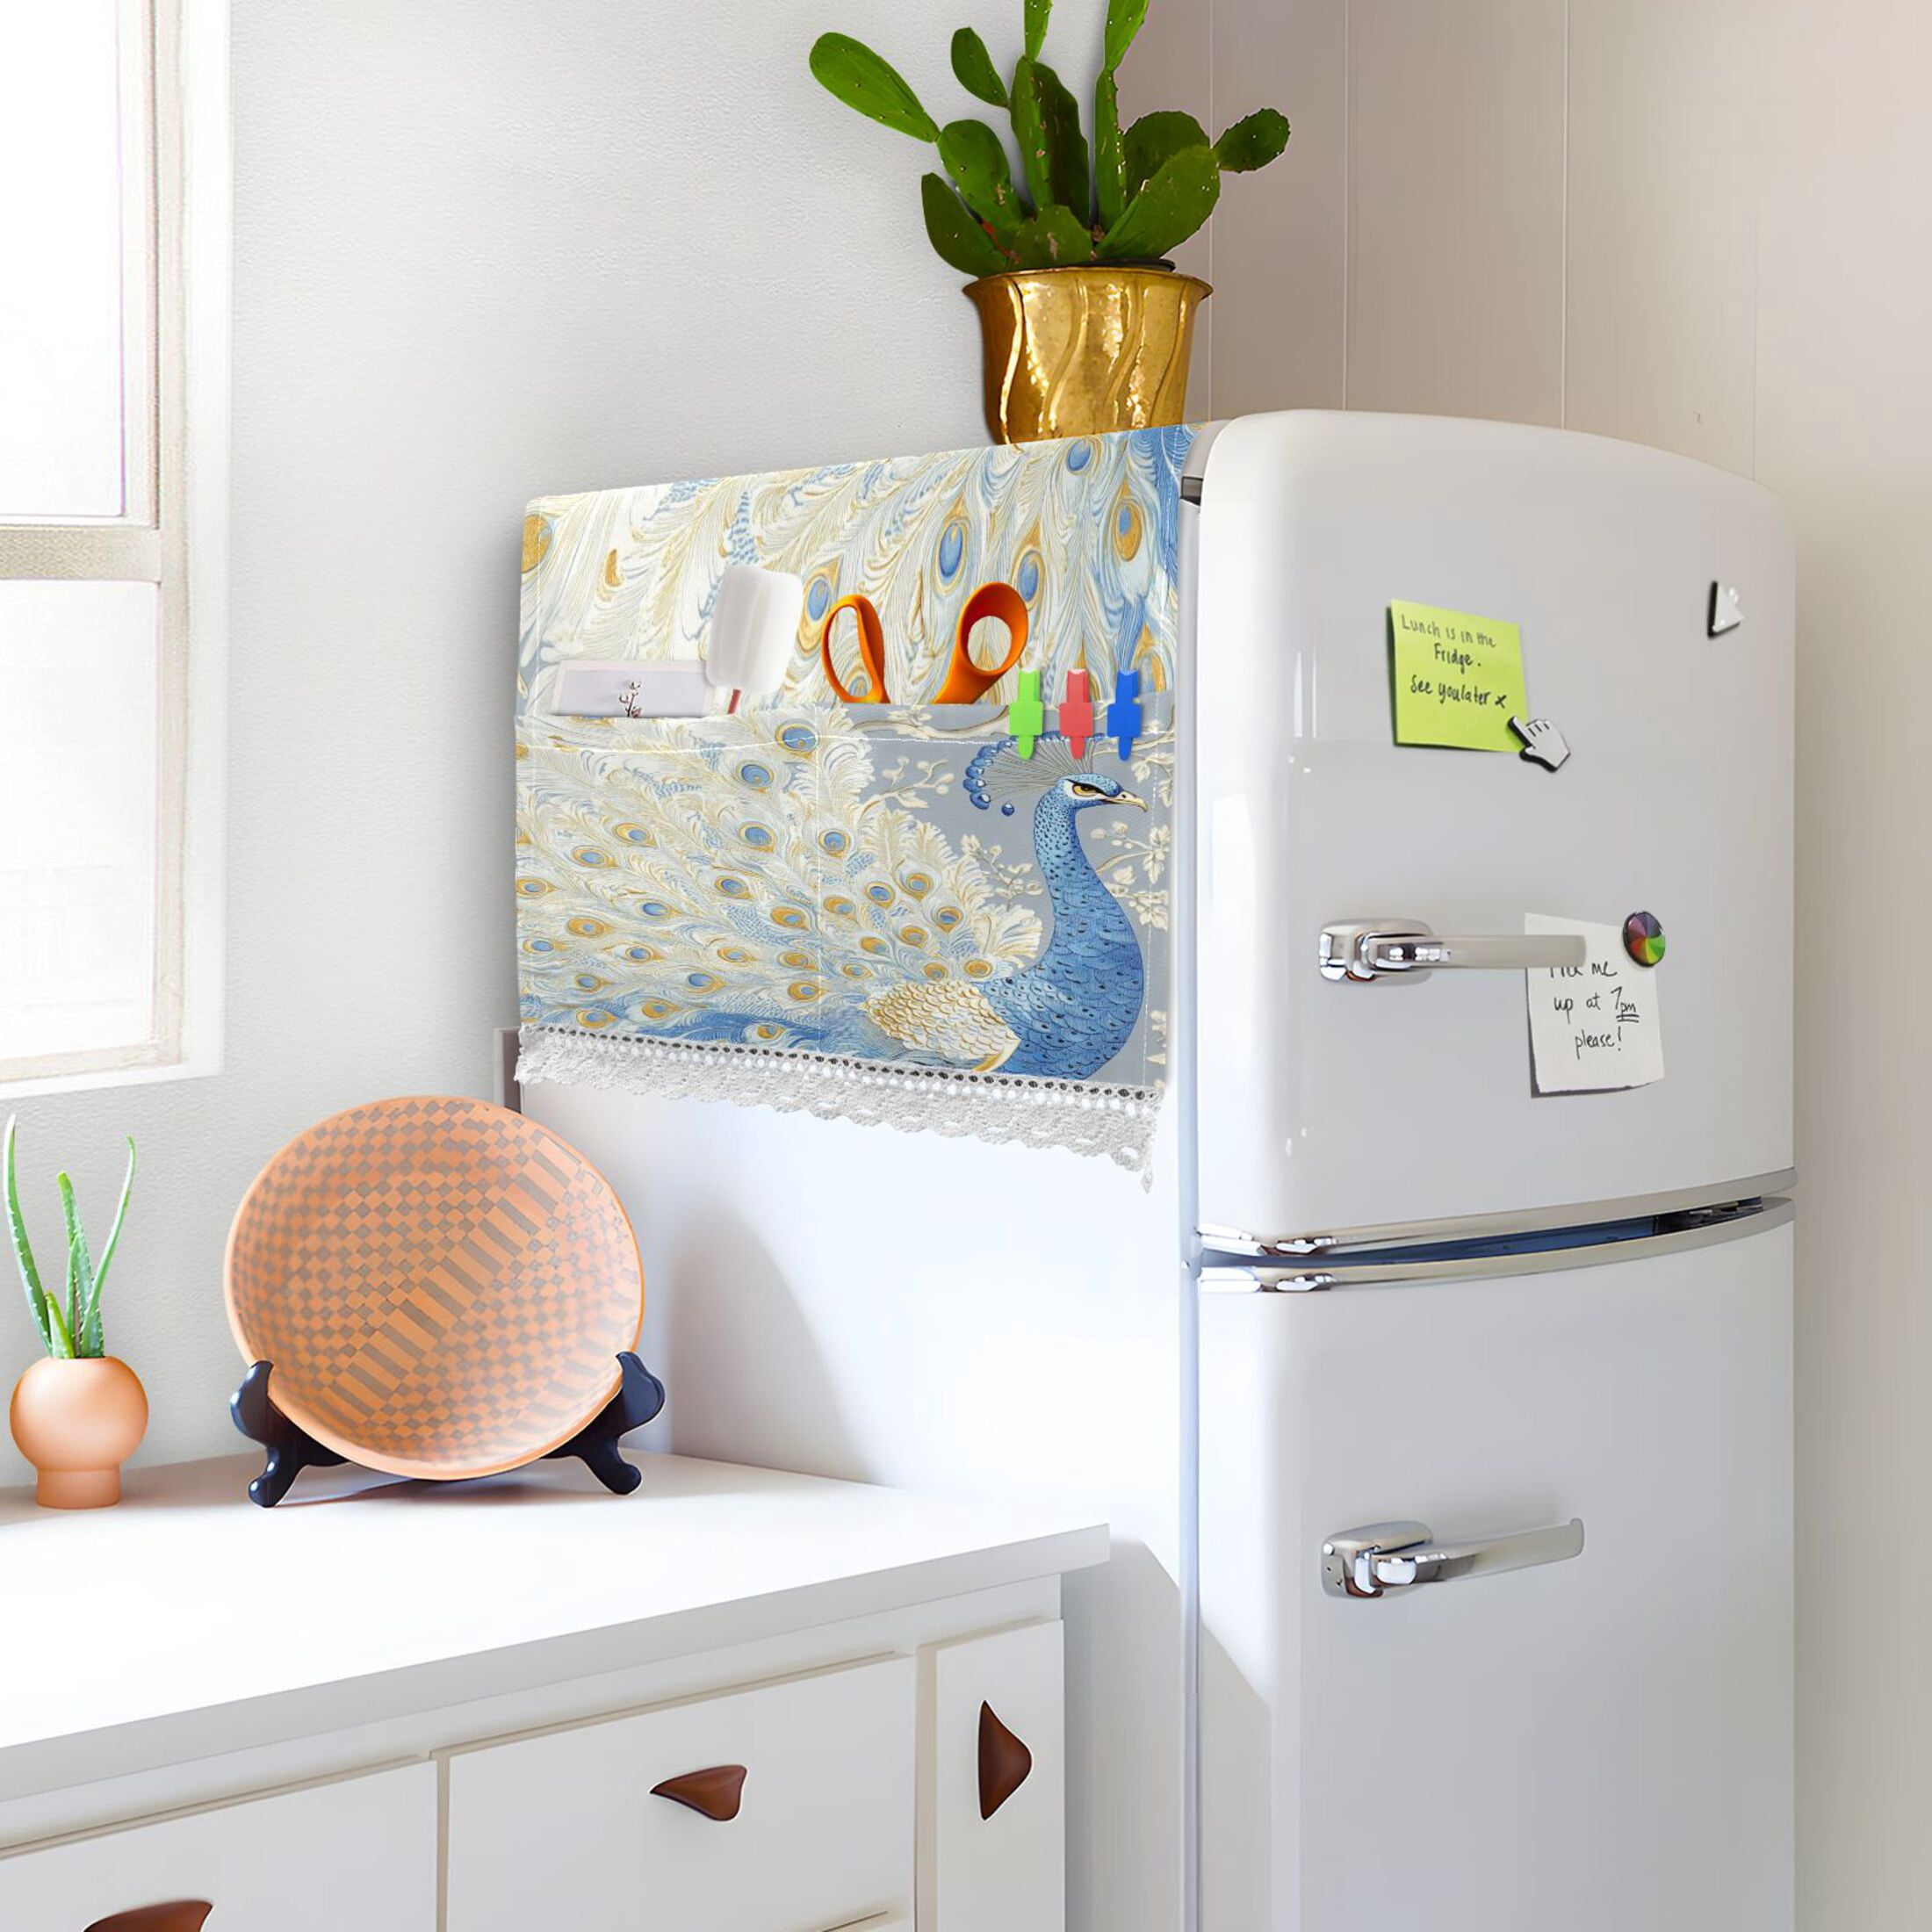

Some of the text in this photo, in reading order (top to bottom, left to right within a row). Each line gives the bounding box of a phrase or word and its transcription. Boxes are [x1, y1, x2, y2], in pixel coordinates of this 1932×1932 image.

[1401, 614, 1496, 648] Lunch is in the
[1410, 674, 1433, 694] See
[1554, 996, 1575, 1025] up
[1586, 992, 1601, 1011] at
[1575, 1026, 1622, 1061] please!
